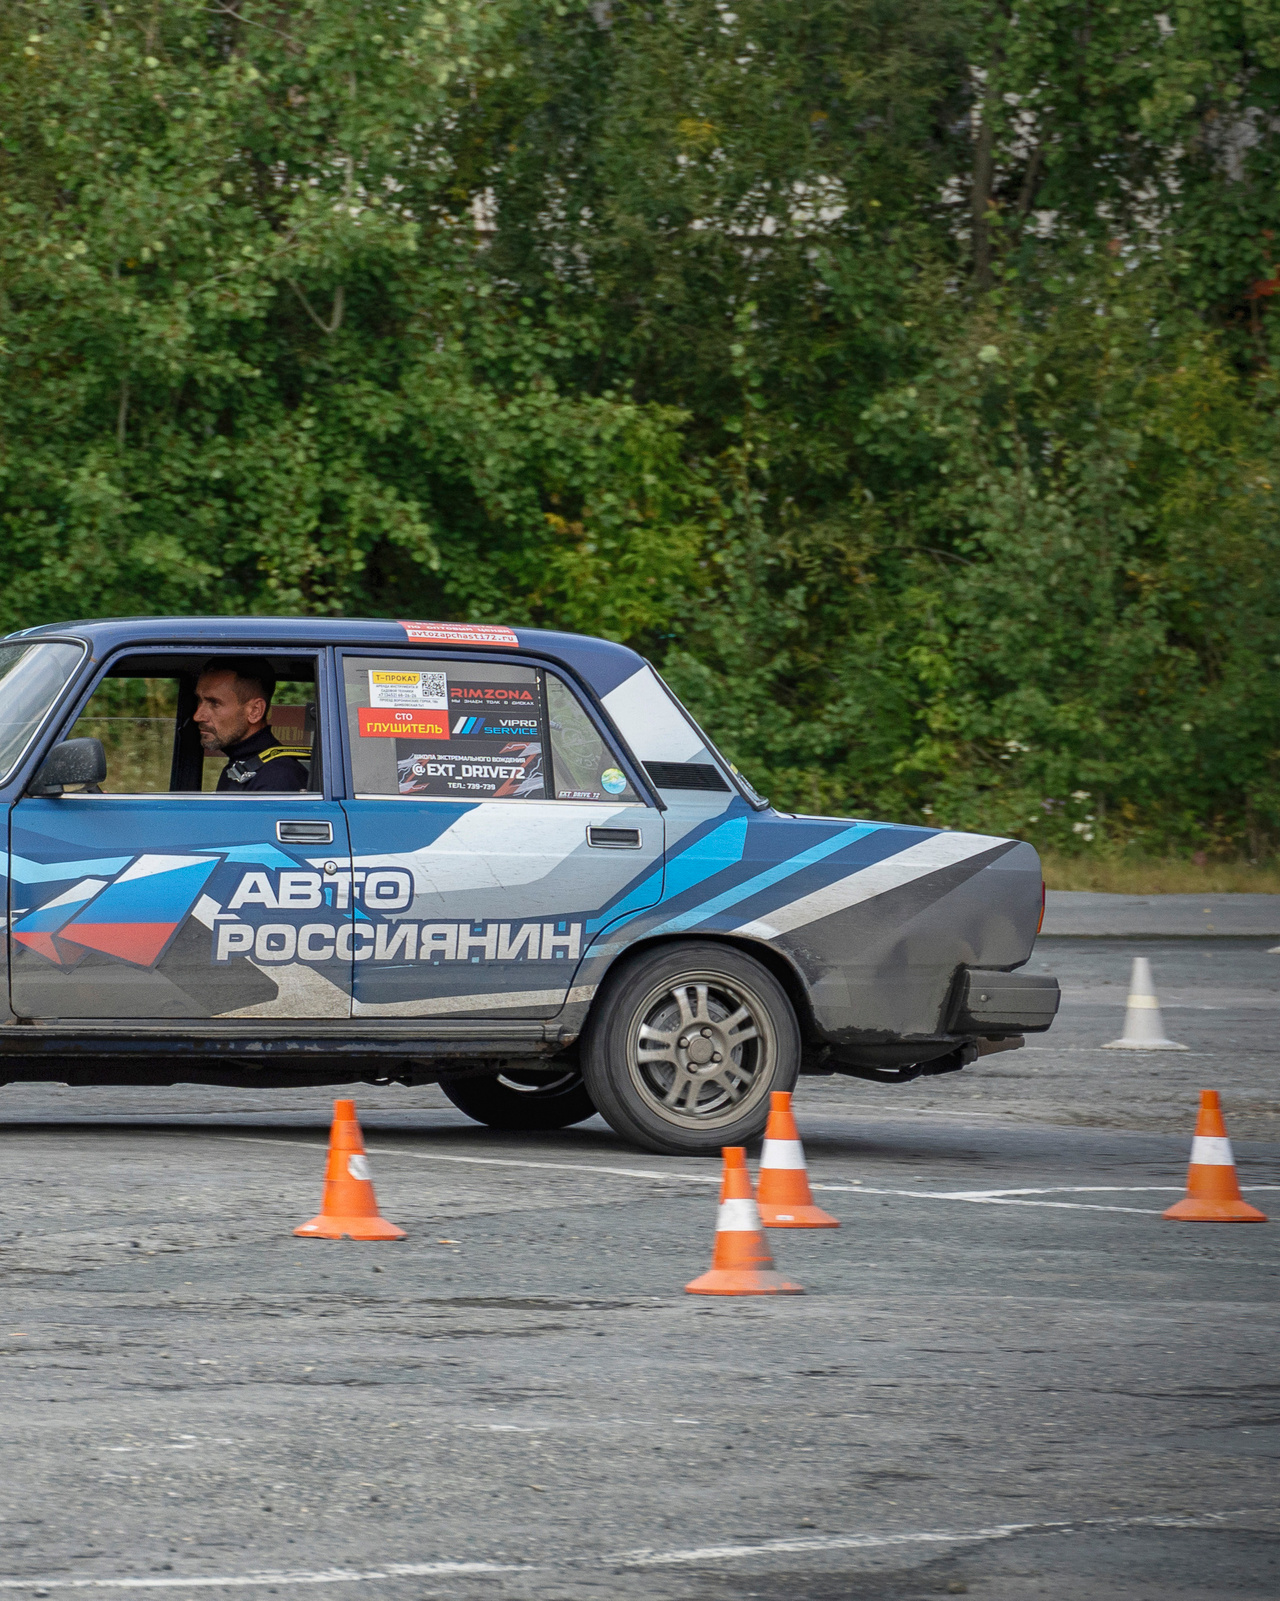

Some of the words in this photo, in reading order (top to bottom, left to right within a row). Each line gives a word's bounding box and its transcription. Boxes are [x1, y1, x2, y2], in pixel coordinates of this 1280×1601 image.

[411, 630, 514, 641] avtozapchasti72.ru
[450, 688, 533, 700] RIMZONA
[366, 723, 443, 734] ГЛУШИТЕЛЬ
[484, 727, 538, 735] SERVICE
[436, 754, 491, 762] ЭКСТРЕМАЛЬНОГО
[412, 763, 525, 780] @EXT_DRIVE72
[228, 872, 410, 909] АВТО
[216, 923, 581, 960] РОССИЯНИН
